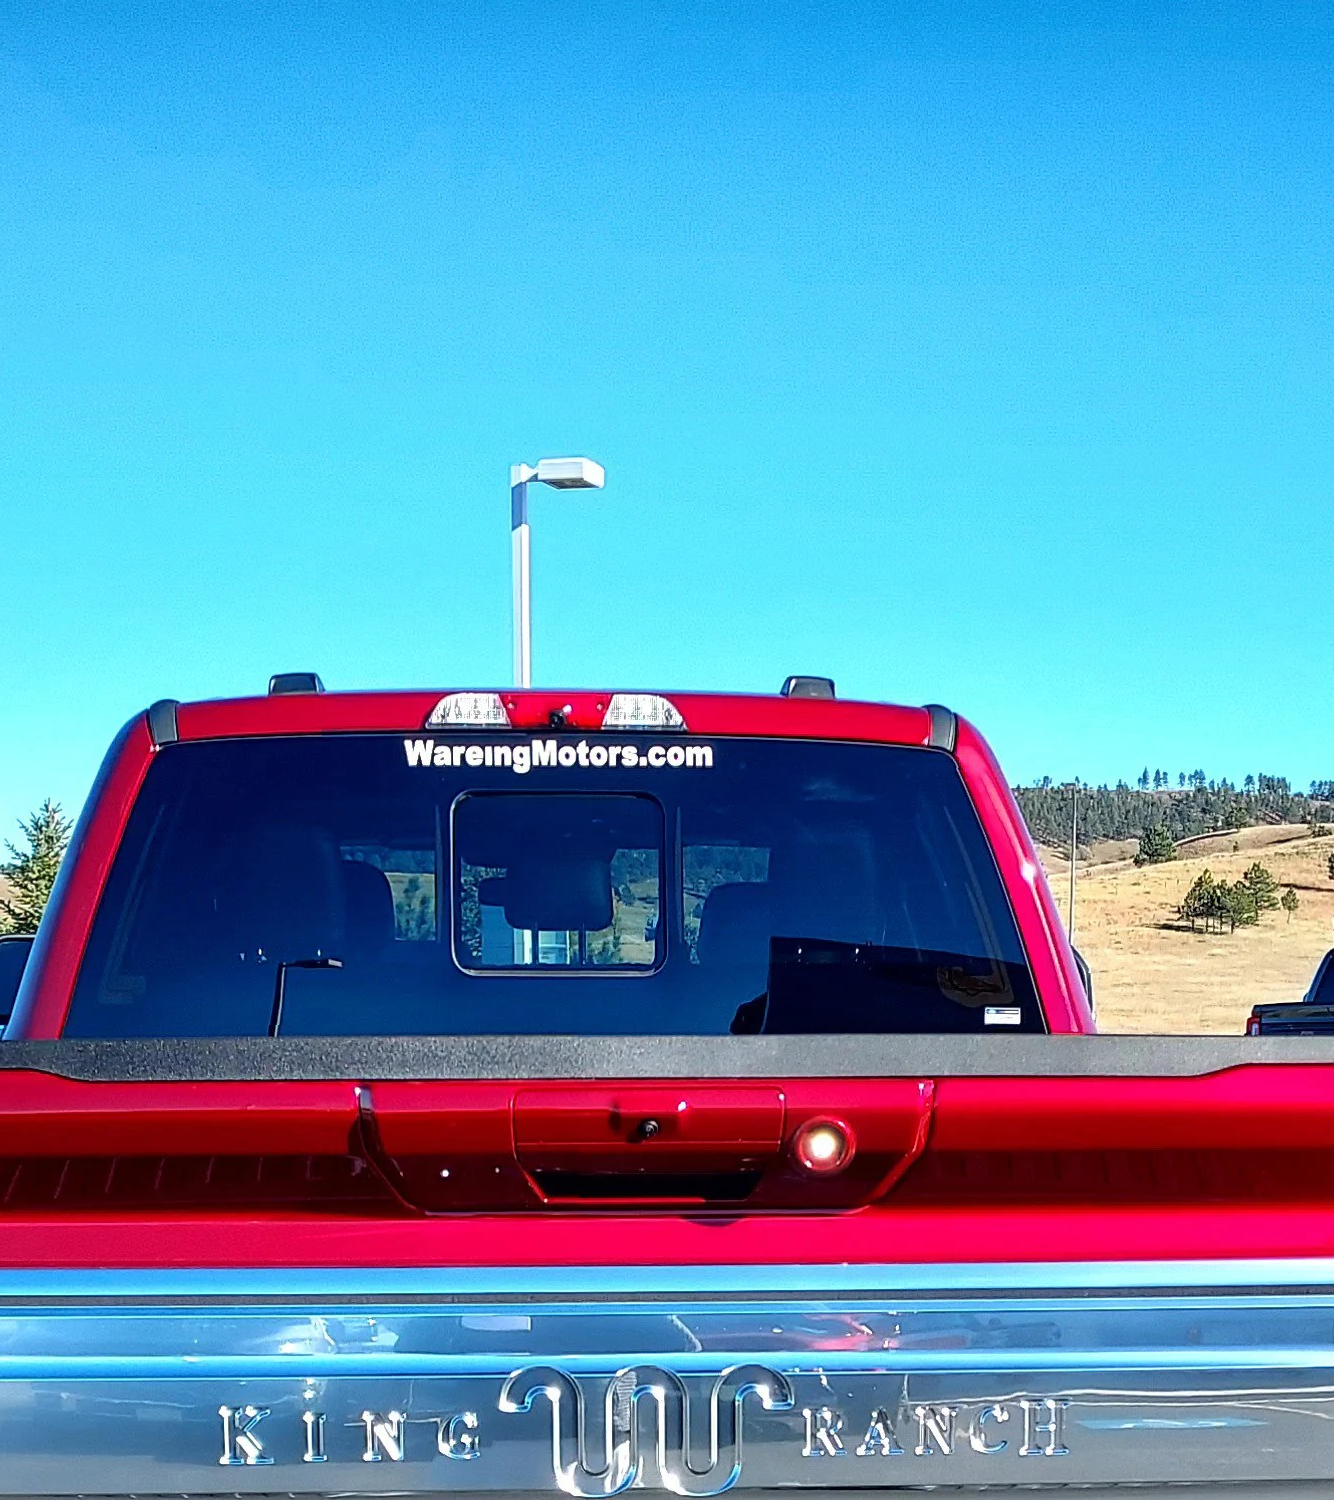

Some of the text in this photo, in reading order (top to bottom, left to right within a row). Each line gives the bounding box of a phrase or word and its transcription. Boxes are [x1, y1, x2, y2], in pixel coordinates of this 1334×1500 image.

[404, 740, 713, 773] WareingMotors.com
[219, 1398, 1072, 1465] KING RANCH
